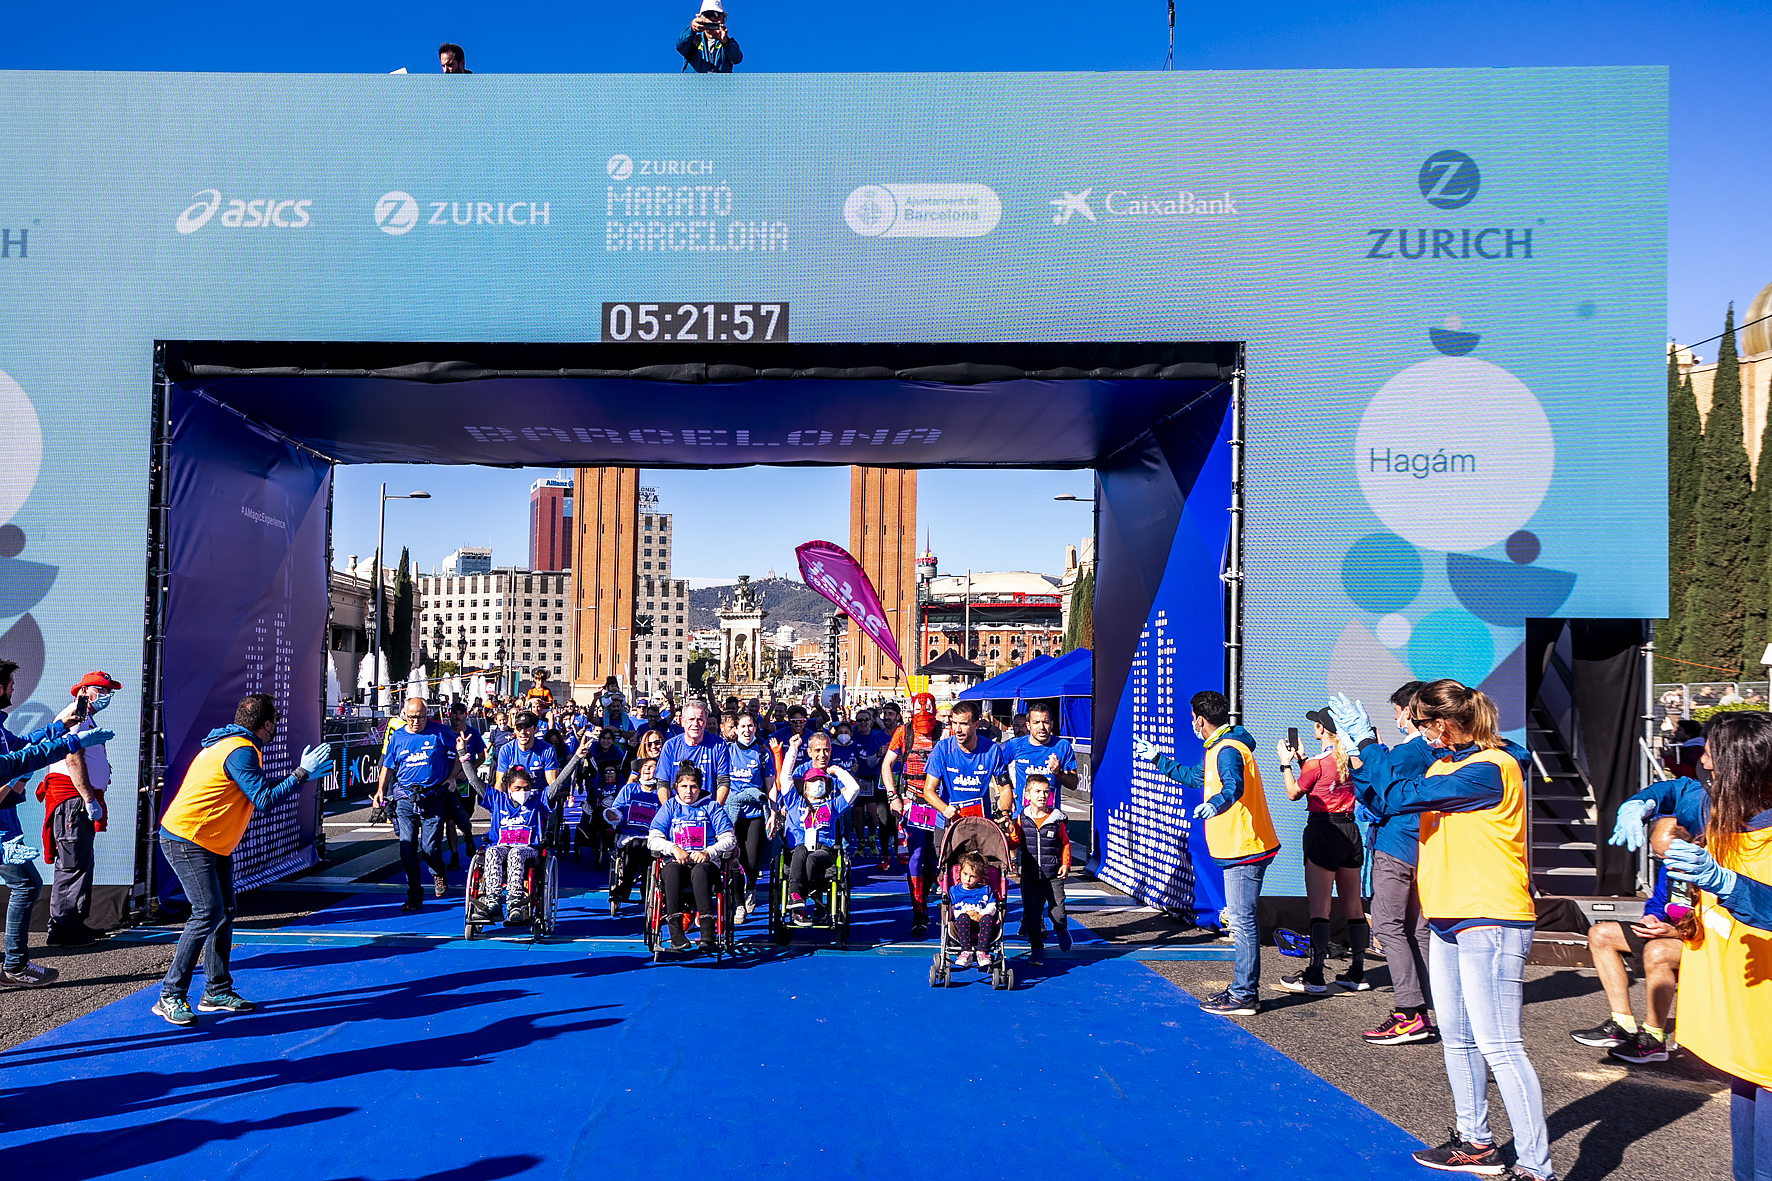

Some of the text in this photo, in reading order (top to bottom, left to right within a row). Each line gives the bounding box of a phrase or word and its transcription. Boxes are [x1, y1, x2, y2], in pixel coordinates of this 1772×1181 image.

[639, 160, 714, 175] ZURICH
[607, 179, 732, 216] MARATÓ
[1105, 190, 1238, 215] CaixaBank
[222, 198, 313, 228] asics
[429, 202, 550, 226] ZURICH
[904, 208, 979, 221] Barcelona
[606, 221, 788, 251] BARCELONA
[1366, 227, 1535, 260] ZURICH
[609, 304, 782, 340] 05:21:57
[464, 426, 943, 446] BARCELONA
[1370, 448, 1476, 479] Hagám
